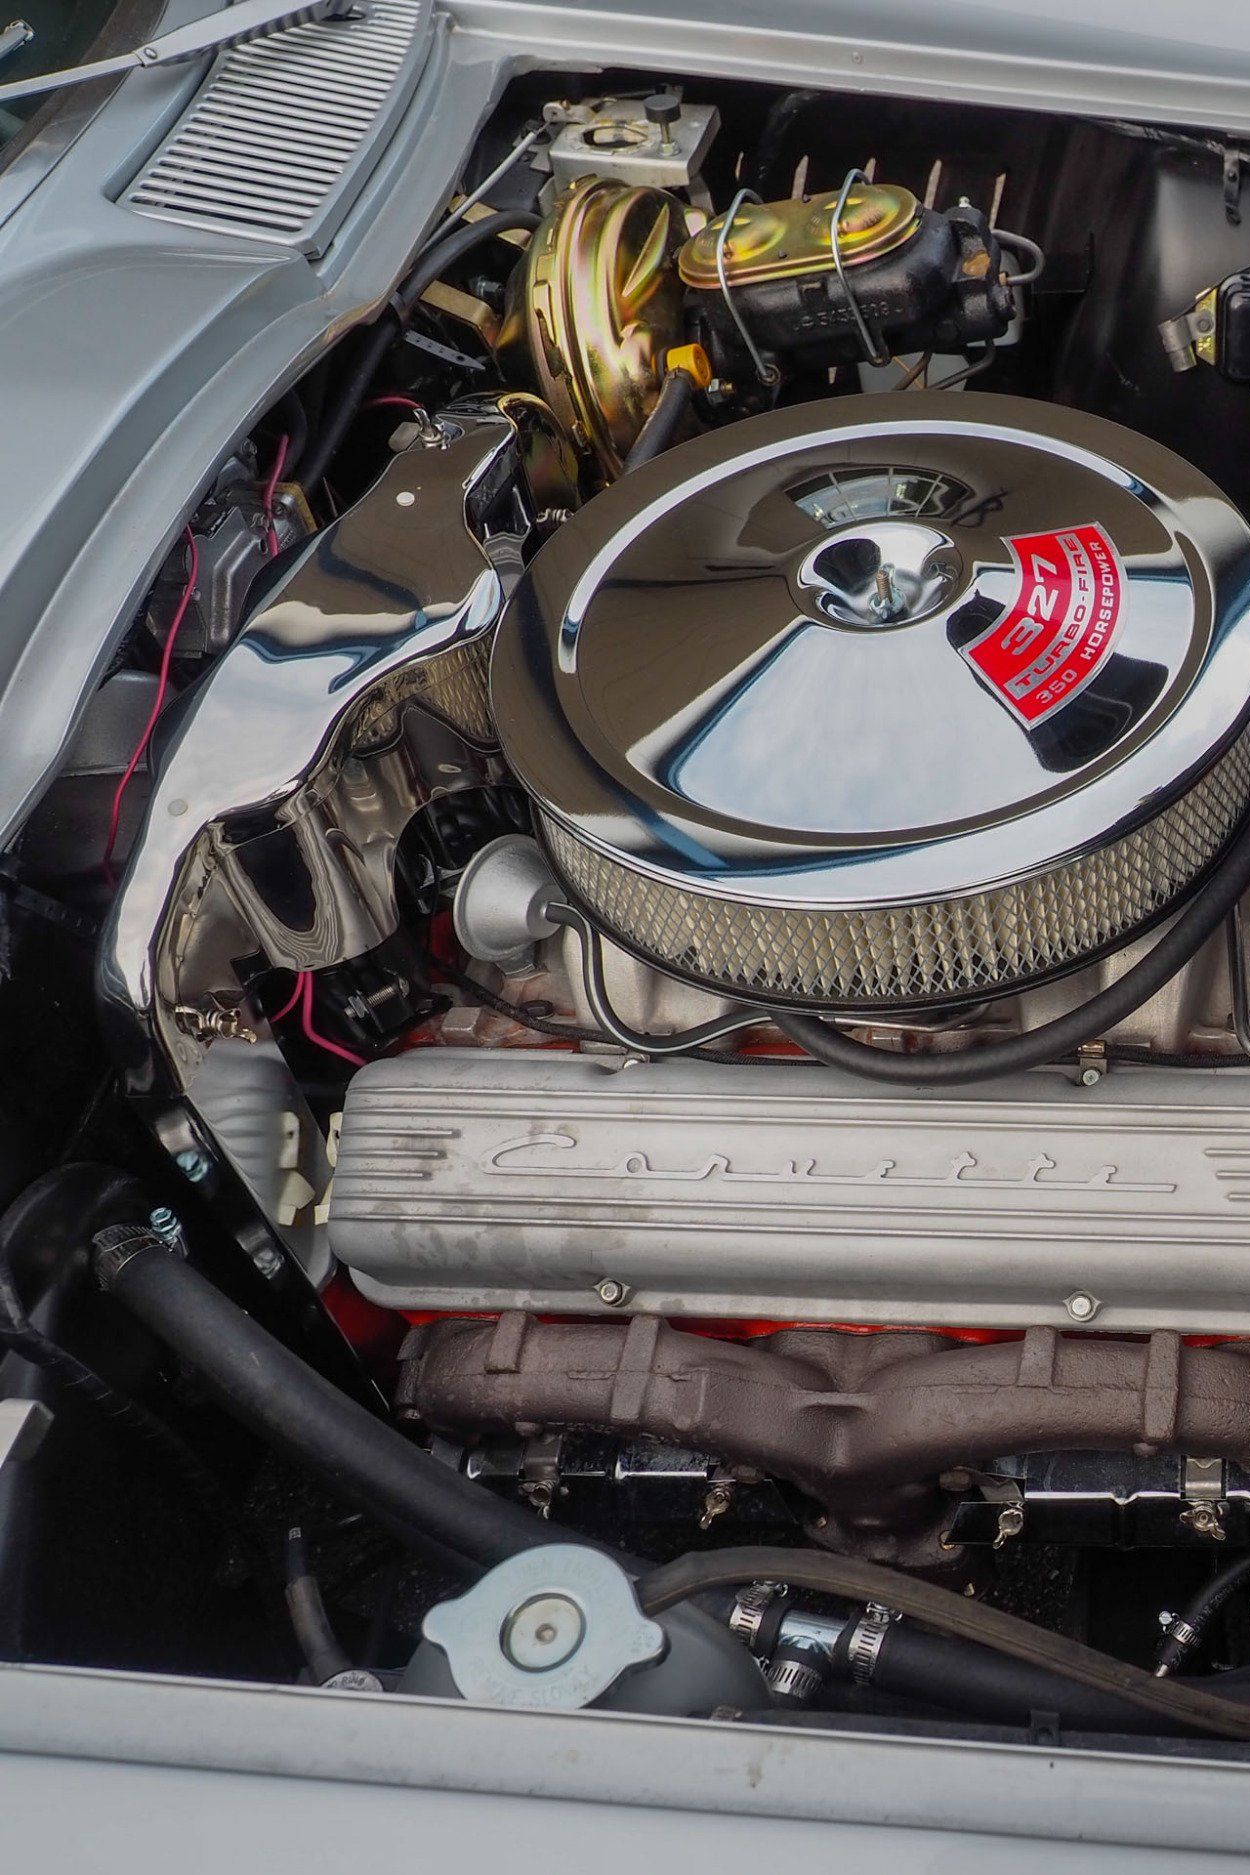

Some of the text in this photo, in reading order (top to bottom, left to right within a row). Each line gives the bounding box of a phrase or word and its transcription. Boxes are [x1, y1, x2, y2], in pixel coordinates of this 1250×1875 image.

[1001, 553, 1059, 656] 327
[1014, 537, 1087, 687] TURBO-FIRE
[1035, 541, 1115, 704] 350 HORSEPOWER
[480, 1133, 1178, 1193] Corvette
